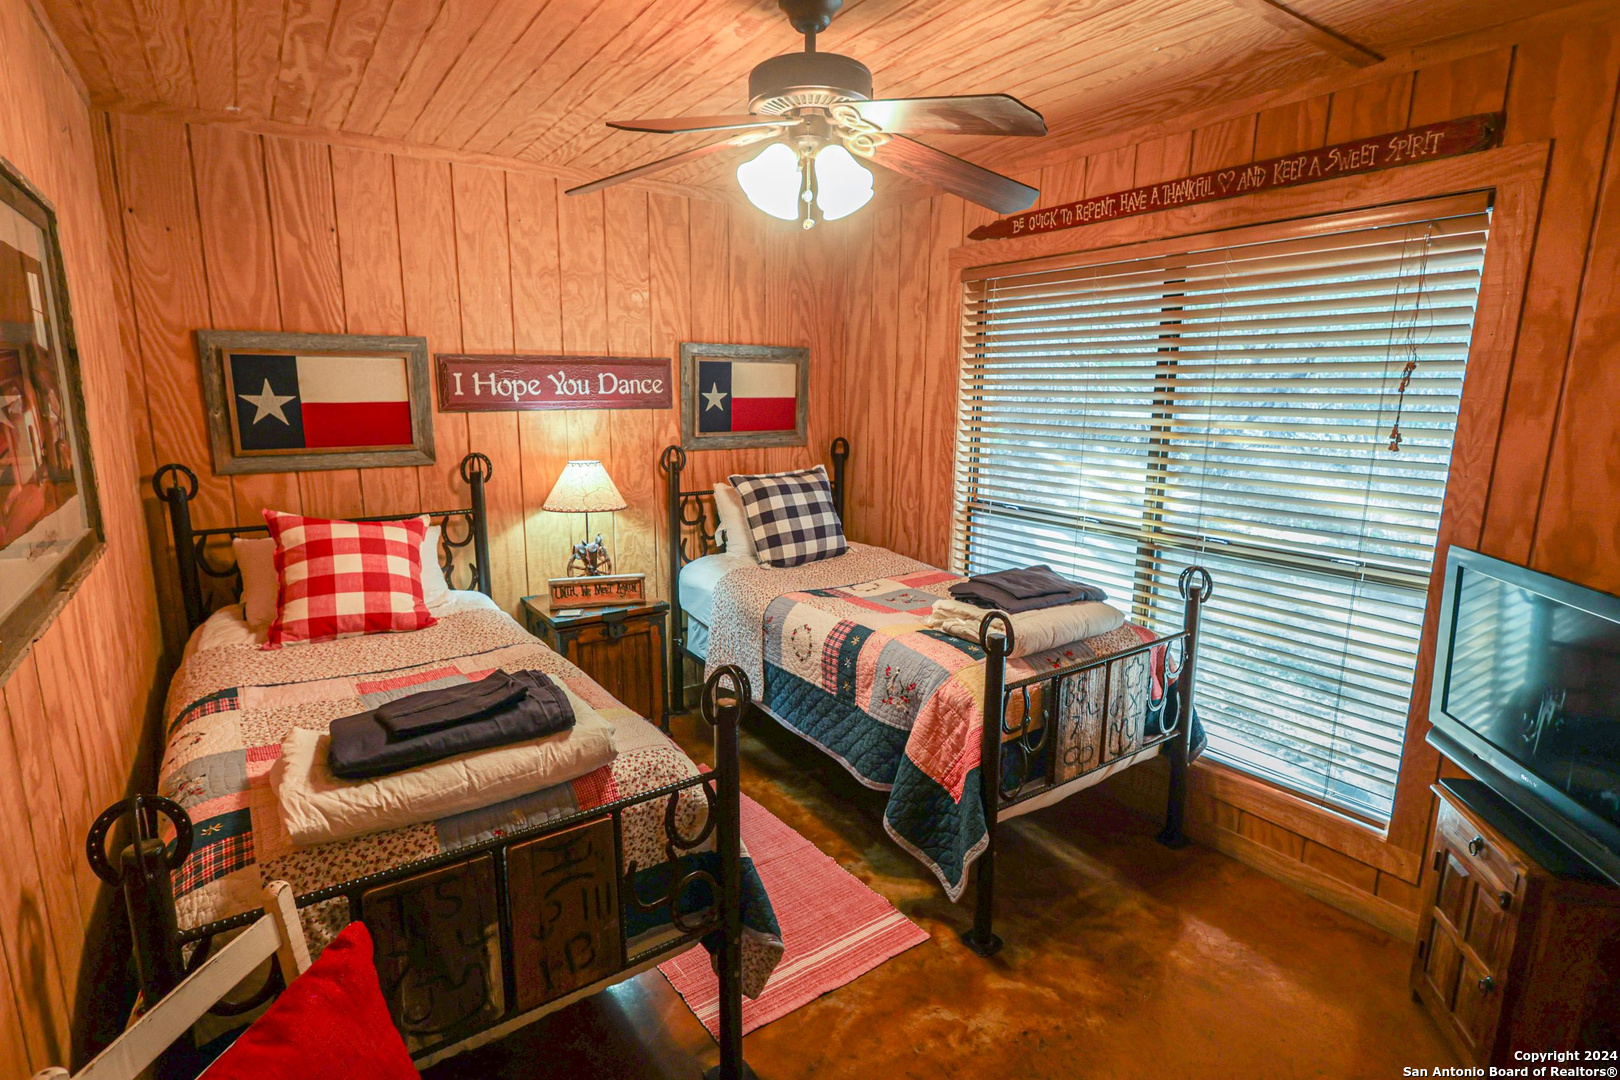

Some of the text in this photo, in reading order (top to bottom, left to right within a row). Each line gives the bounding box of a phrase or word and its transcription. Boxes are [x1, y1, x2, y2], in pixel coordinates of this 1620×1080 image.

[1012, 131, 1445, 234] BE QUICK TO REPENT, HAVE A THANKFUL AND KEEP A SWEET SPIRIT
[452, 371, 664, 402] I Hope You Dance
